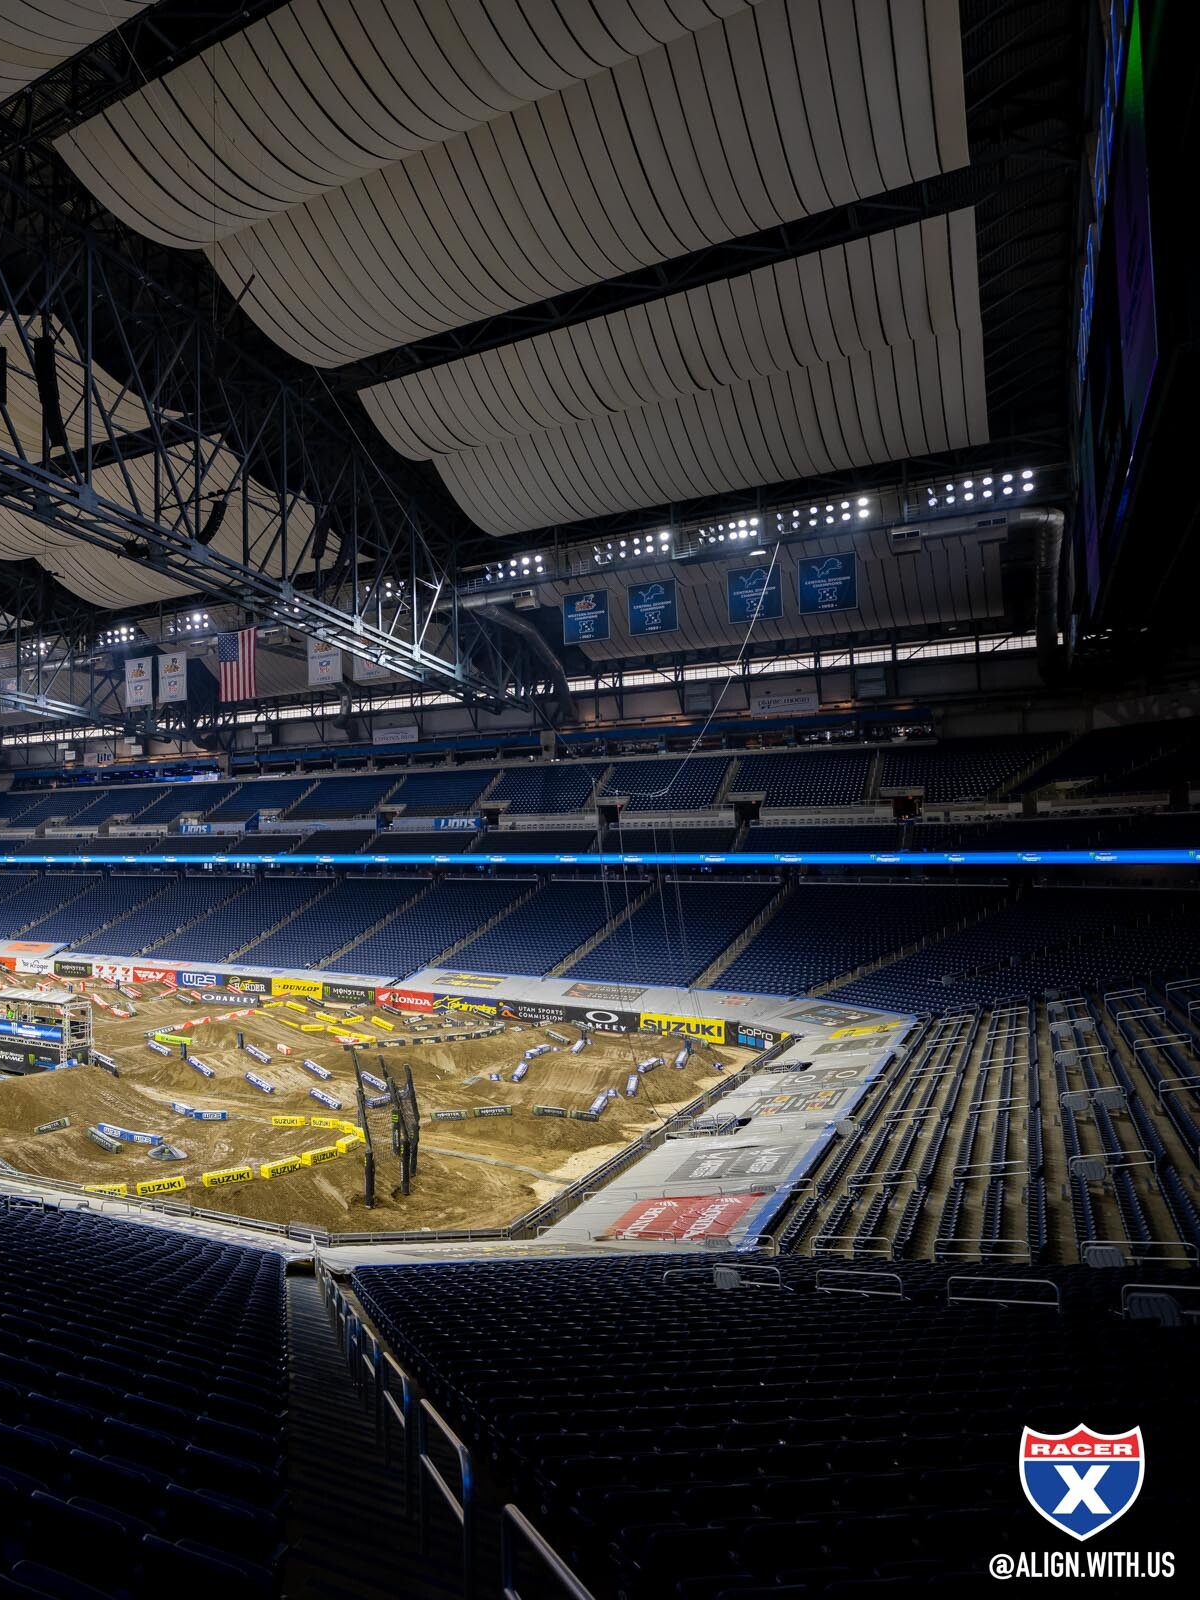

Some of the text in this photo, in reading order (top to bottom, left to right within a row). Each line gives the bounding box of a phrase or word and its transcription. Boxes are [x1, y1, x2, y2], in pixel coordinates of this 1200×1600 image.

[97, 752, 112, 763] Lite
[441, 818, 476, 829] LIONS
[61, 964, 86, 972] MONSTER
[138, 970, 165, 981] FLY
[182, 972, 216, 985] WPS
[233, 982, 266, 992] HARDER
[282, 984, 320, 992] DUNLOP
[332, 987, 366, 997] MONSTER
[215, 994, 256, 1005] OAKLEY
[395, 993, 432, 1007] HONDA
[518, 1005, 564, 1017] UTAH SPORTS
[518, 1012, 564, 1022] COMMISSION
[643, 1019, 722, 1038] SUZUKI
[738, 1025, 774, 1041] GoPro
[304, 1060, 330, 1080] FALKEN
[247, 1075, 273, 1094] FALKEN
[310, 1089, 340, 1110] FALKEN
[273, 1118, 299, 1126] SUZUKI
[312, 1119, 331, 1127] SUZUKI
[312, 1150, 339, 1164] SUZUKI
[271, 1163, 301, 1177] SUZUKI
[209, 1171, 250, 1186] SUZUKI
[140, 1180, 182, 1195] SUZUKI
